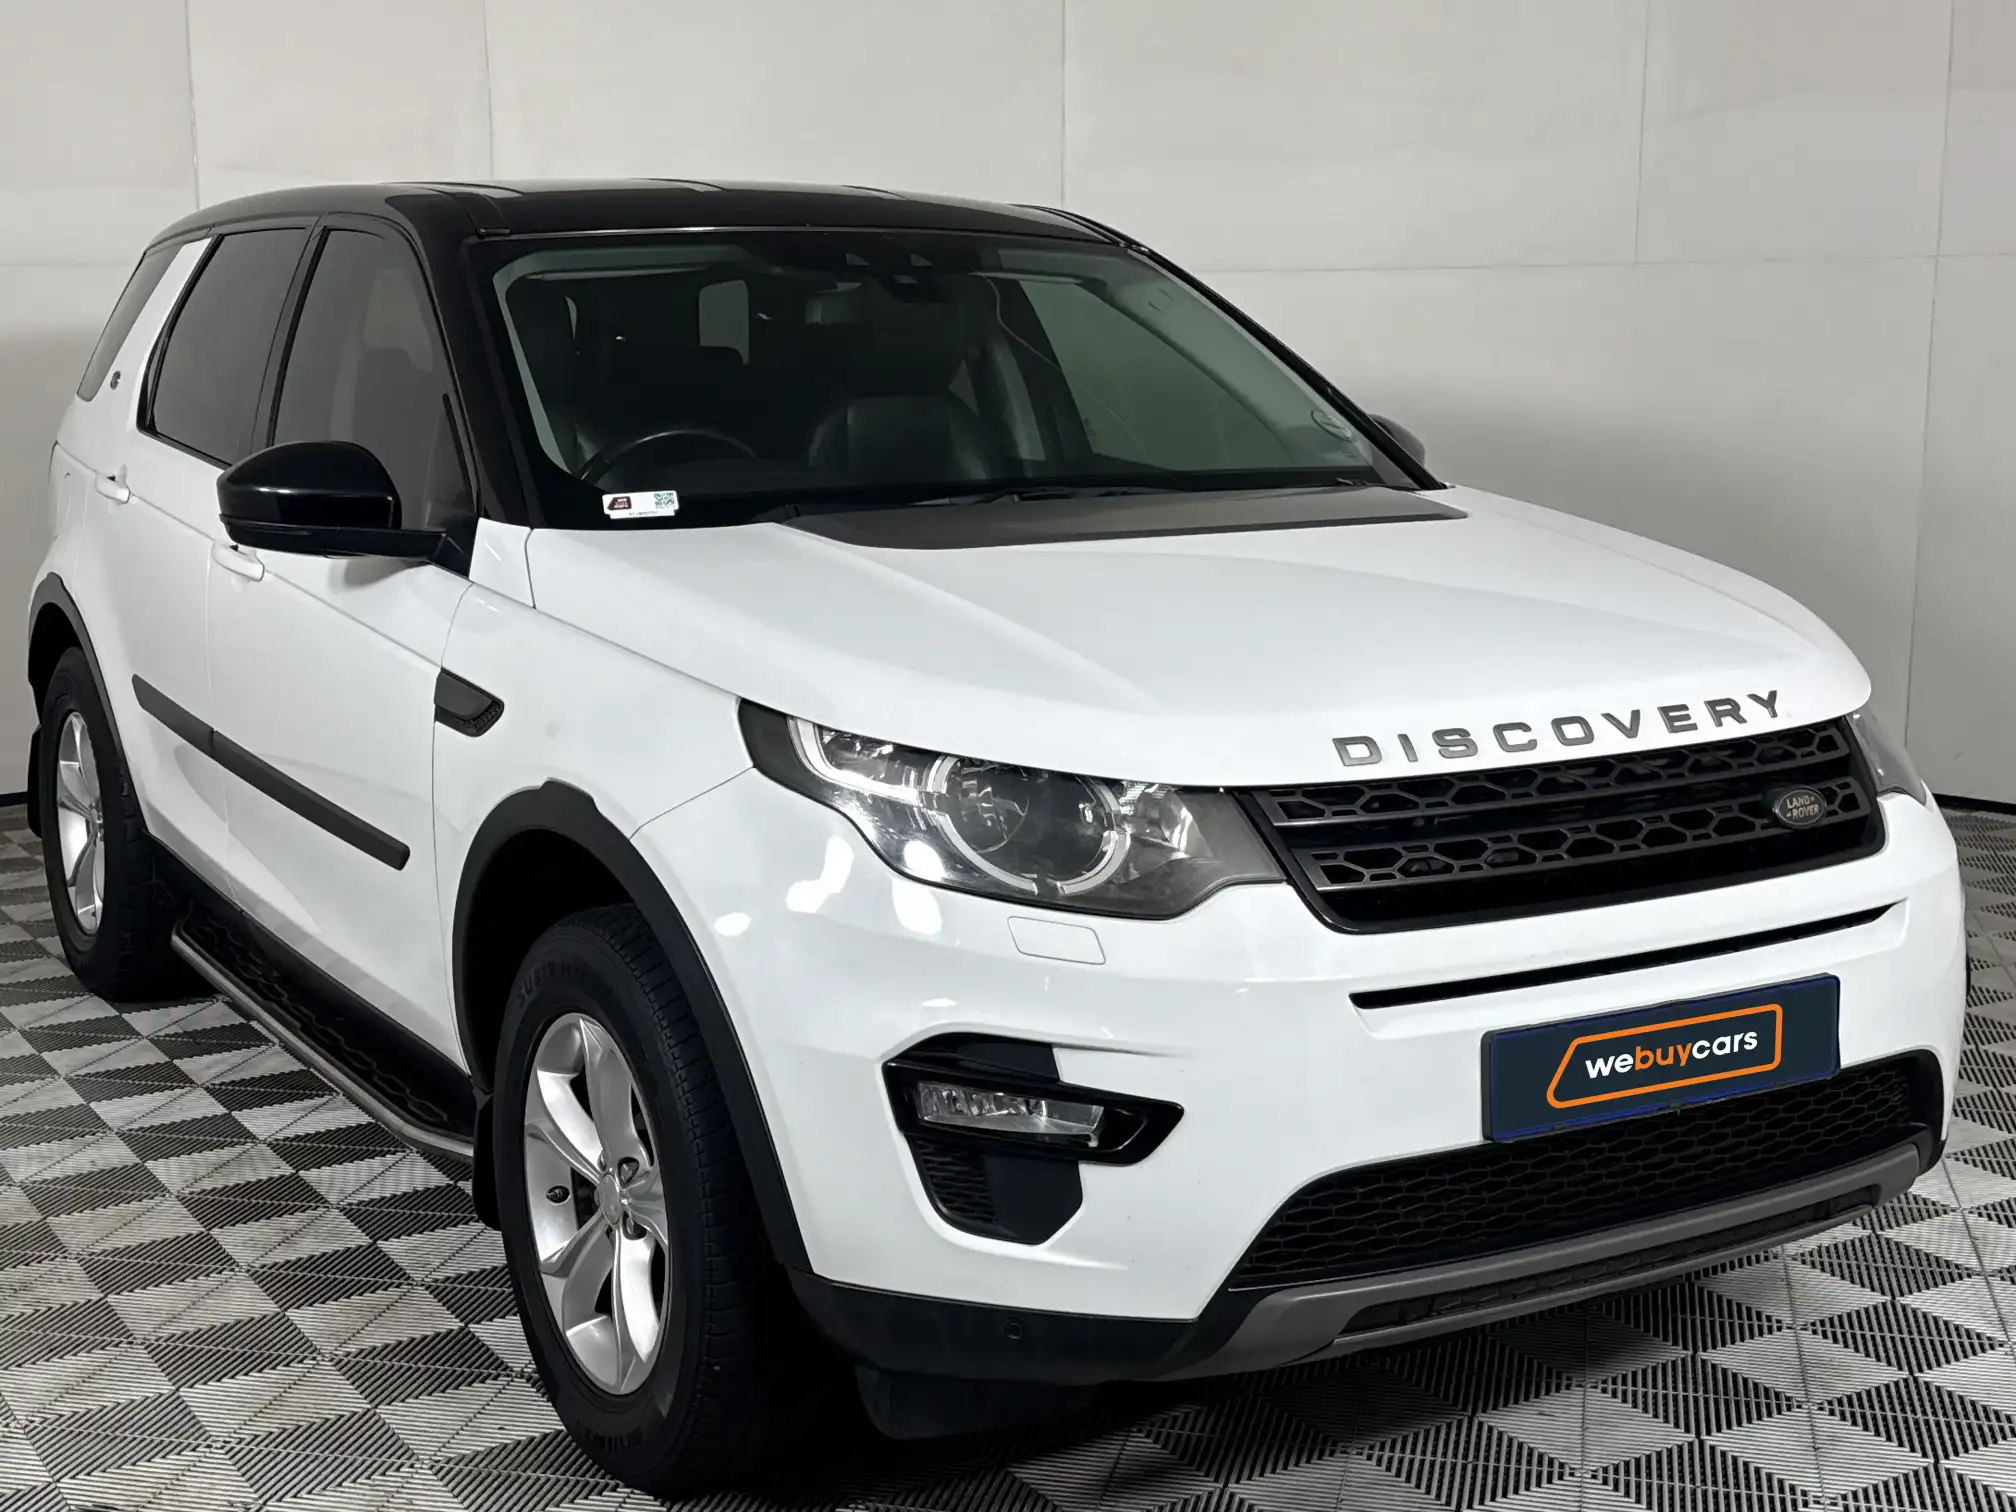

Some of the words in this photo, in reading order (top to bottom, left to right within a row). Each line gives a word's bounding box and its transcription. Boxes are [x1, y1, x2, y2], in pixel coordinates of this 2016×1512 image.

[1332, 690, 1781, 767] DISCOVERY
[1786, 795, 1810, 809] LAND
[1792, 804, 1819, 820] ROVER
[1585, 1029, 1758, 1079] webuycars
